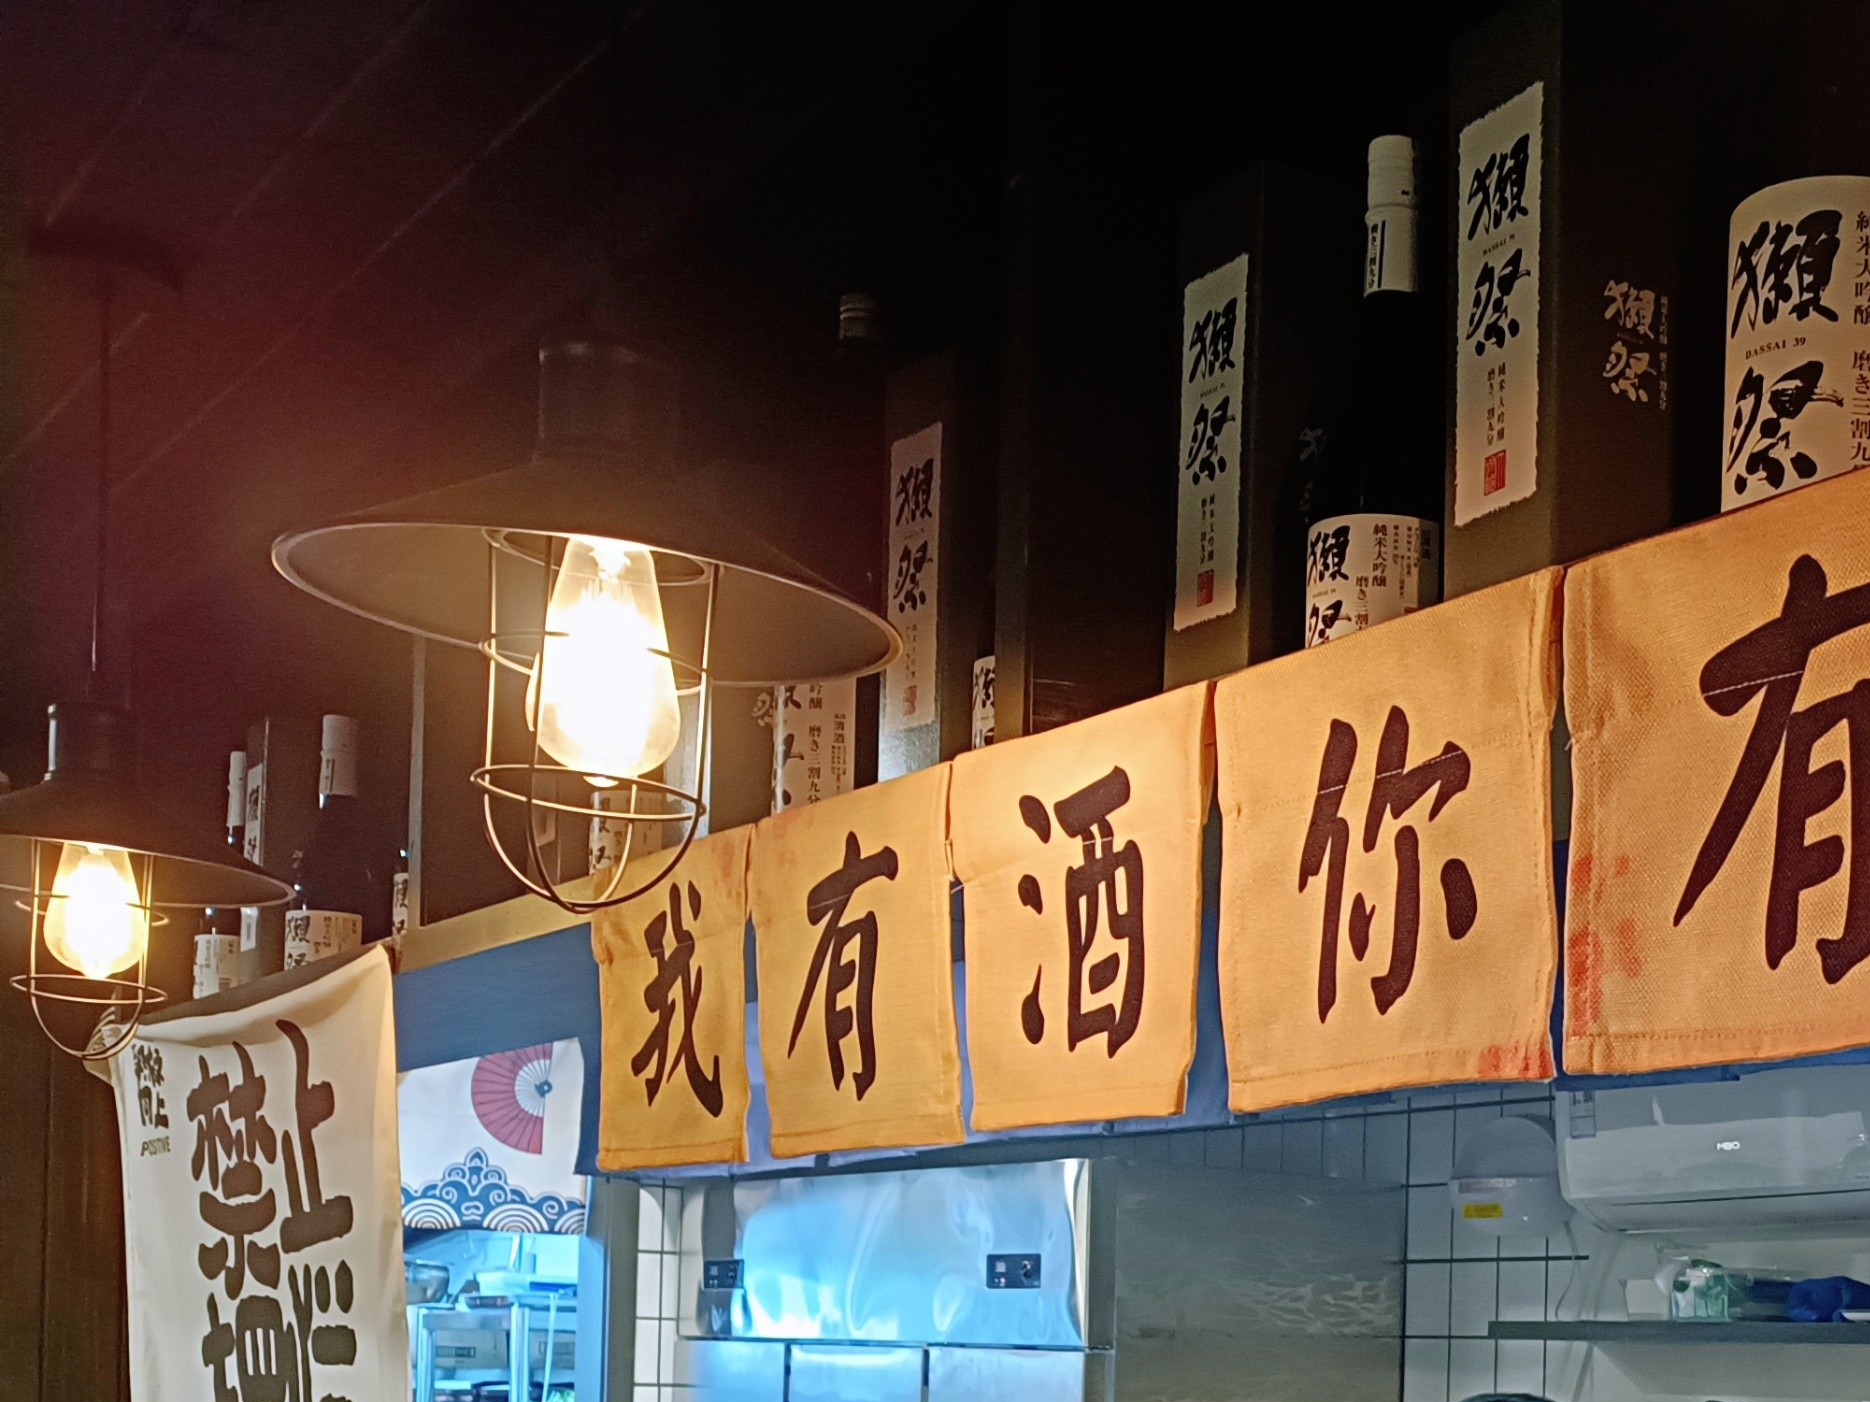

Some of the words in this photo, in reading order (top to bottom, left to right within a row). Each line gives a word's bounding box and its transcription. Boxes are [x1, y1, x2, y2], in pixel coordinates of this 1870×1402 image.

[1726, 209, 1845, 496] 獺祭
[1745, 338, 1787, 361] DASSAI
[1792, 336, 1807, 348] 39
